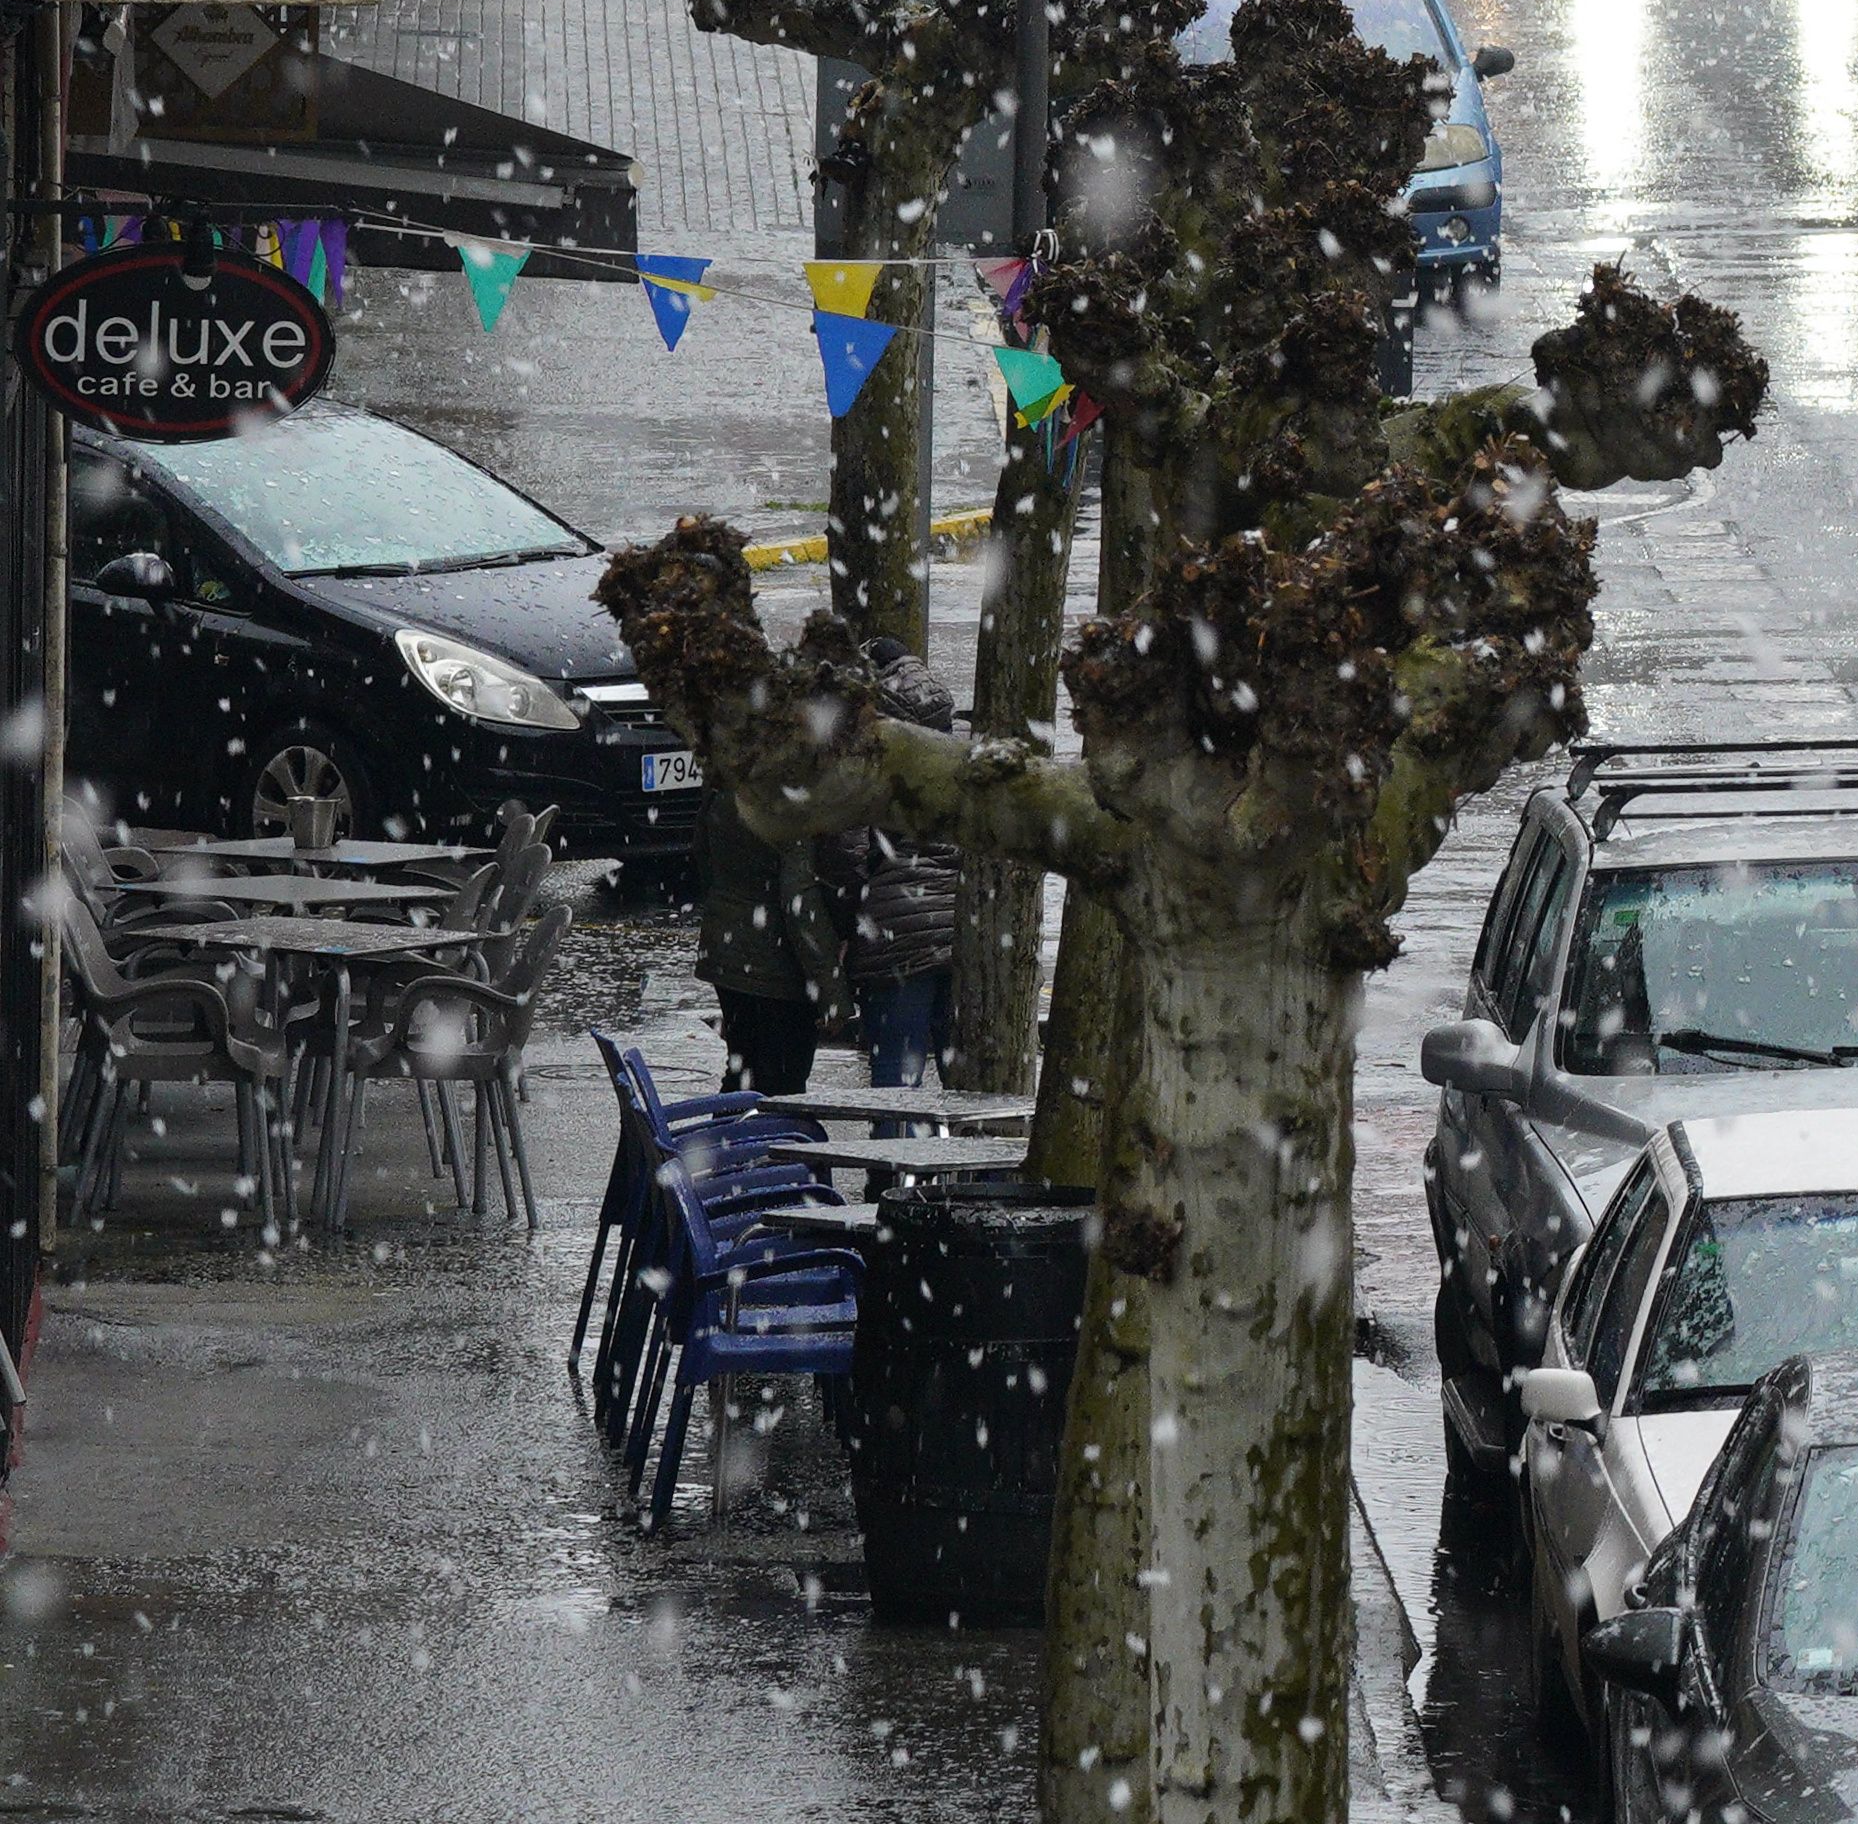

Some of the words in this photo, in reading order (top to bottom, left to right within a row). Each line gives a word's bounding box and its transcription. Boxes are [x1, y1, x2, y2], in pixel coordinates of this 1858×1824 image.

[44, 298, 306, 368] deluxe
[77, 371, 159, 398] cafe
[170, 374, 196, 398] &
[209, 374, 272, 399] bar
